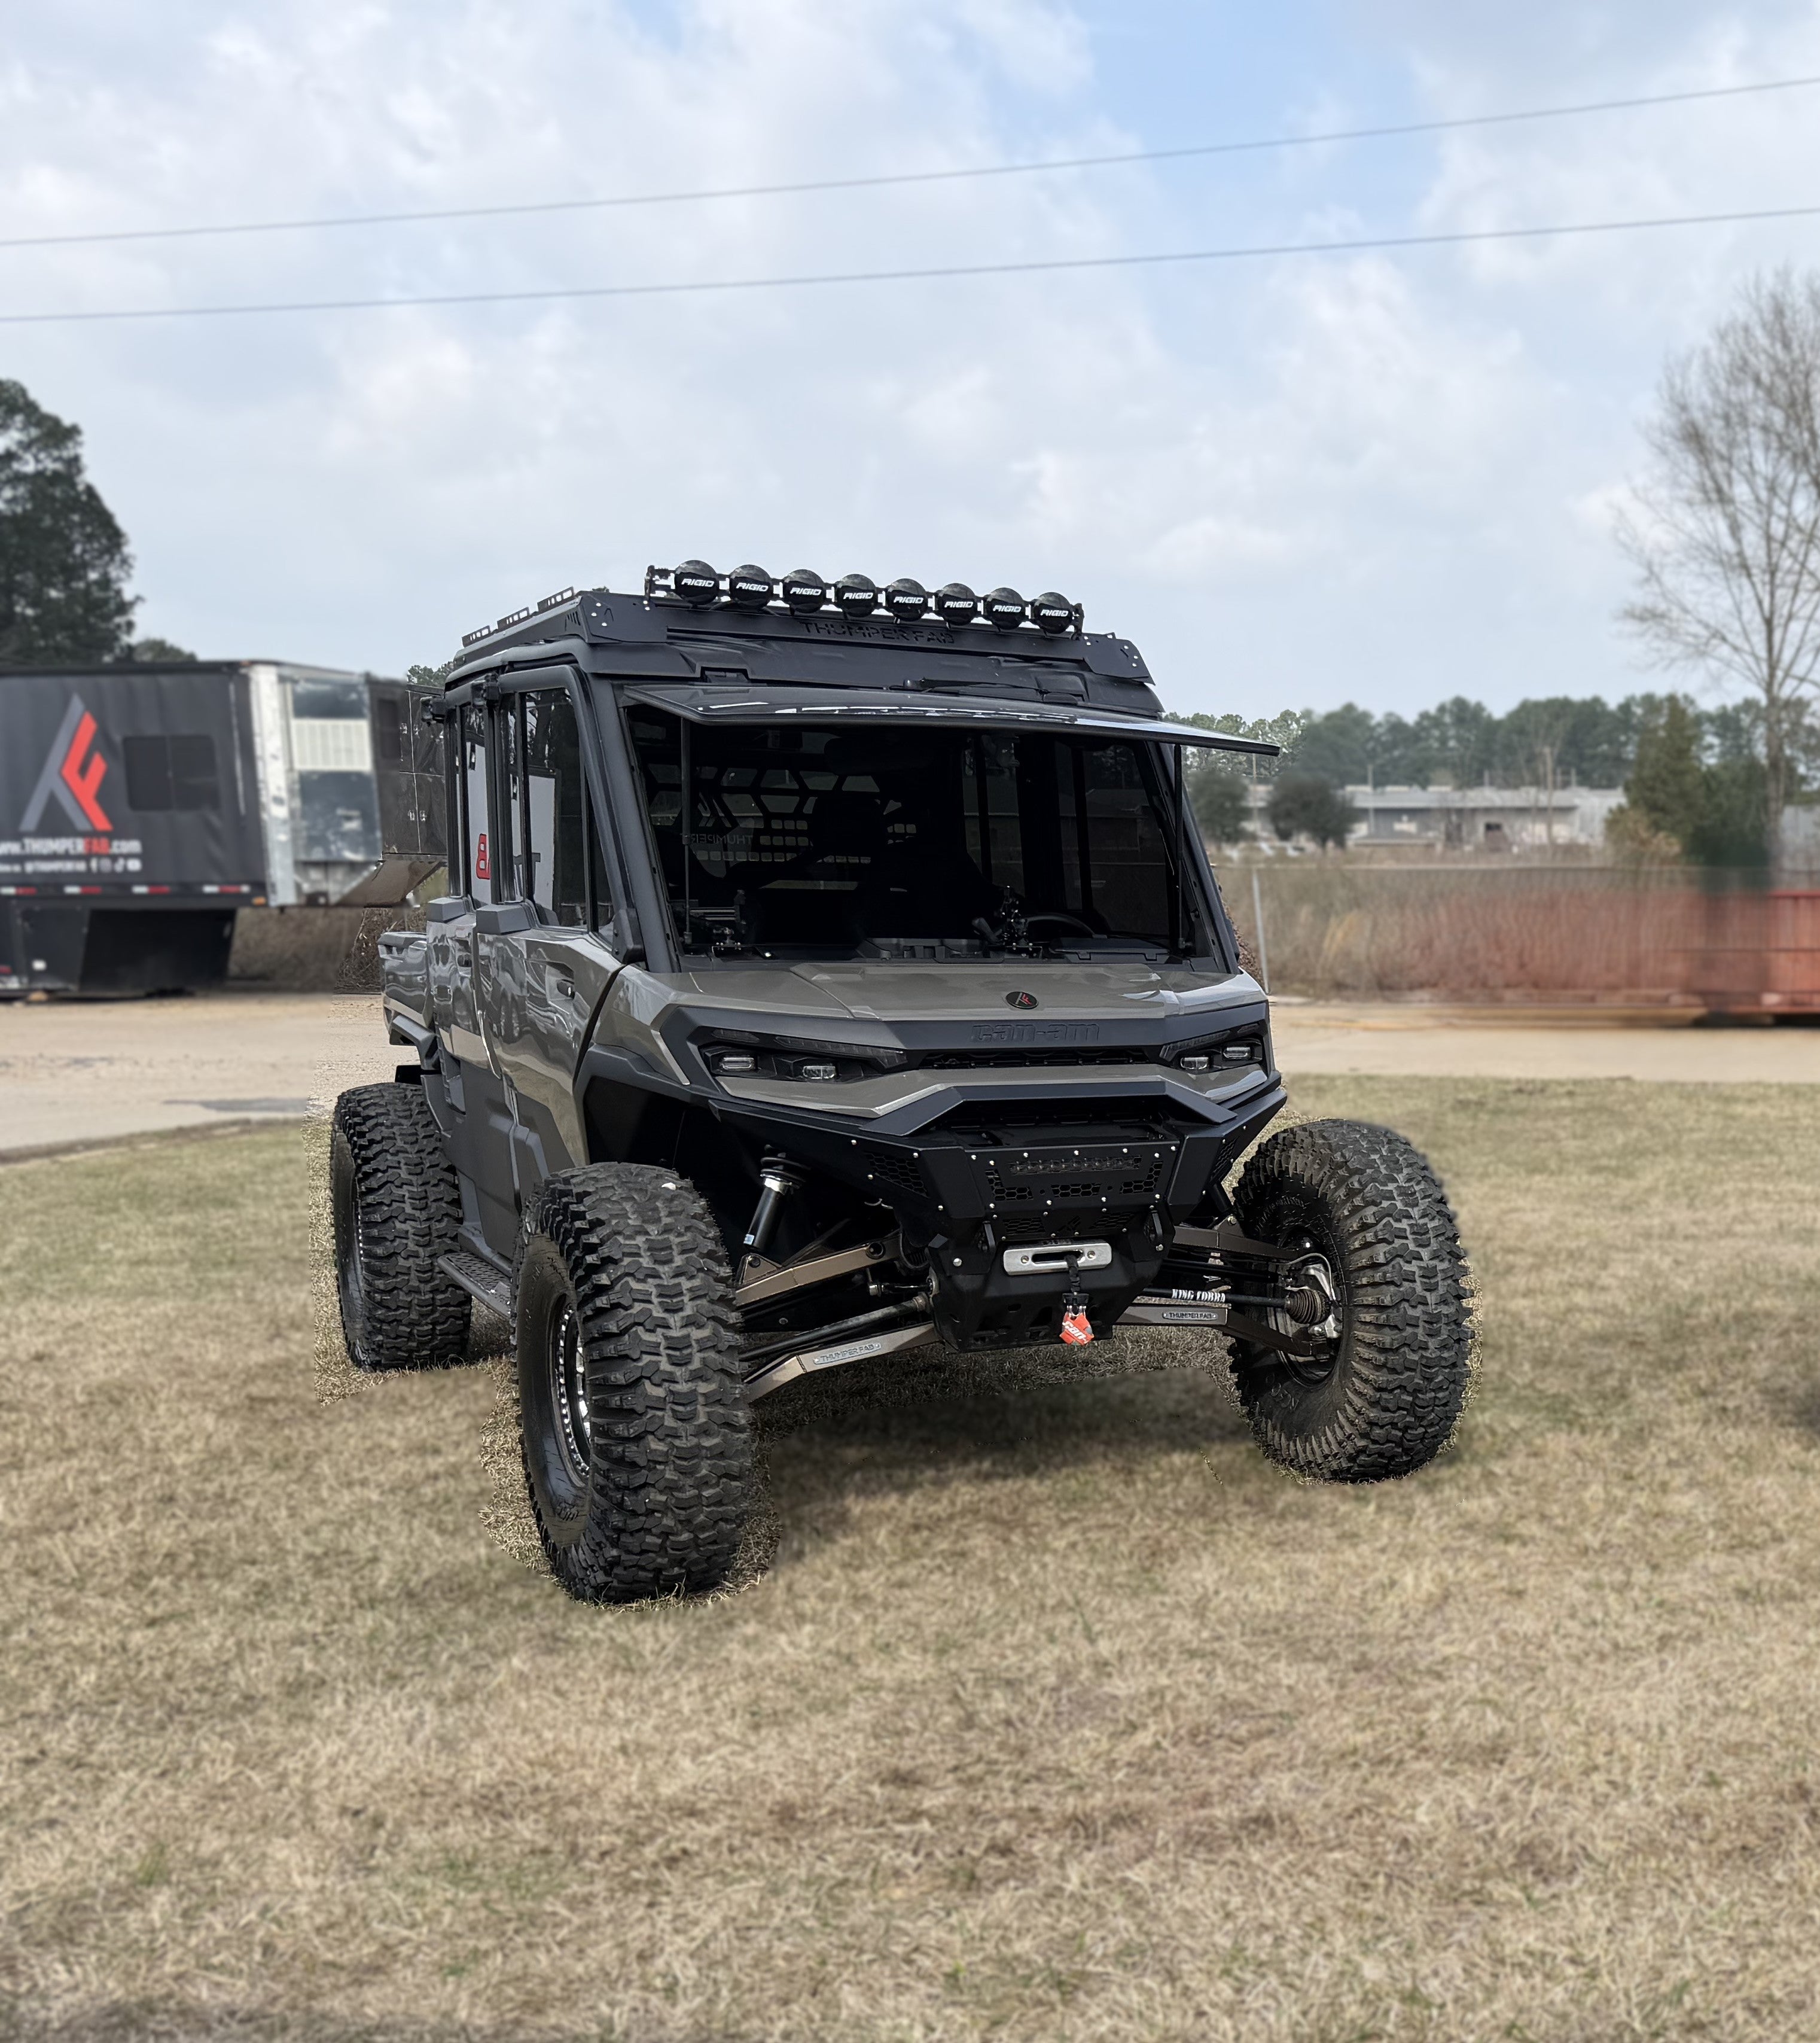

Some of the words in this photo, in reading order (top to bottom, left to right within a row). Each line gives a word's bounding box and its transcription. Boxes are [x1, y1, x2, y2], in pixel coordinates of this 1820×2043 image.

[681, 579, 714, 587] RIGID
[736, 583, 769, 592] RIGID
[789, 587, 821, 596] RIGID
[798, 621, 909, 640] THUMPER
[913, 631, 954, 644] FAB
[1172, 1289, 1194, 1299] KING
[820, 1348, 858, 1362] THUMPER
